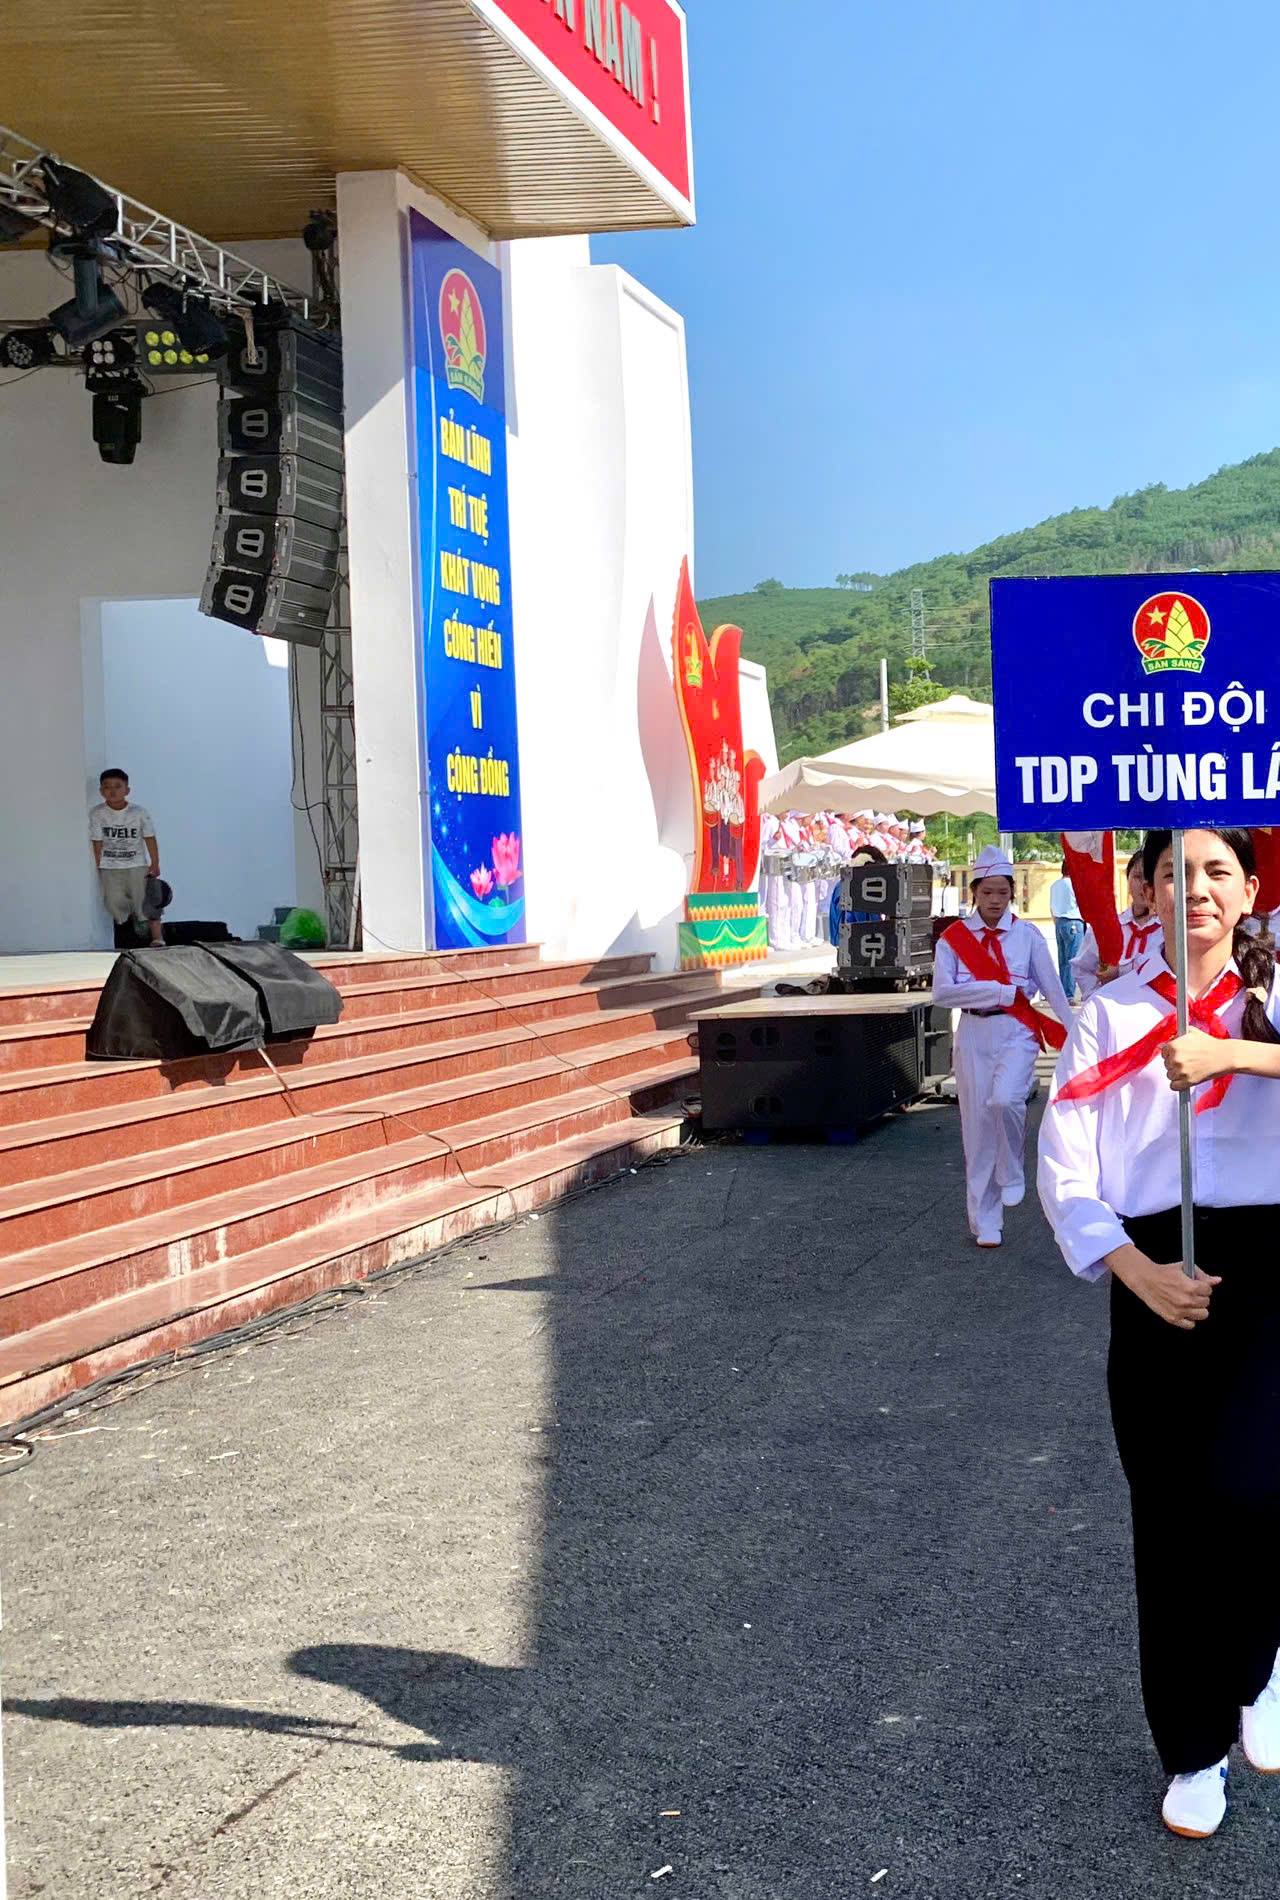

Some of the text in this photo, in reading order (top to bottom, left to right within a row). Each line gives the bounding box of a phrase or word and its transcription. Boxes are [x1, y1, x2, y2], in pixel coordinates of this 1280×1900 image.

[447, 484, 467, 530] TRÍ
[440, 548, 501, 610] KHÁT VỌNG
[443, 607, 503, 670] CỐNG HIẾN
[1082, 680, 1266, 733] CHI ĐỘI
[447, 746, 479, 802] CỘNG
[1014, 755, 1099, 805] TDP
[1111, 743, 1228, 803] TÙNG
